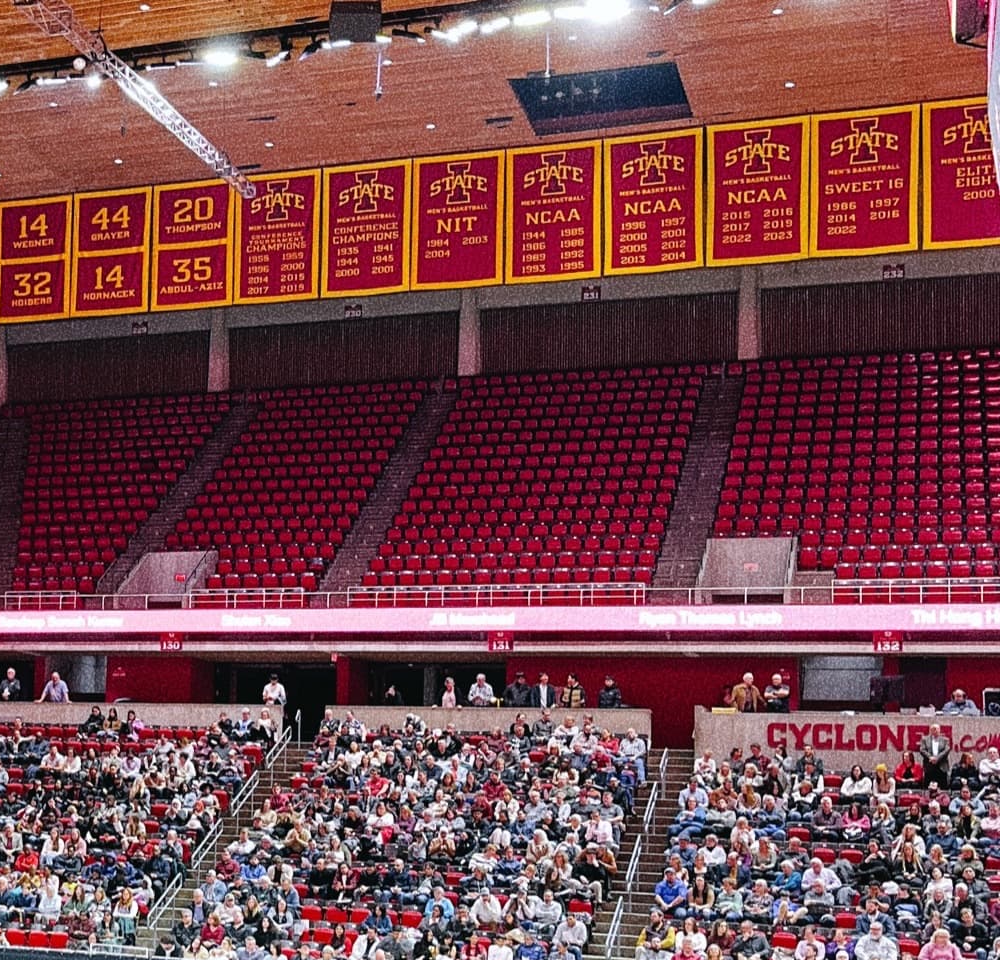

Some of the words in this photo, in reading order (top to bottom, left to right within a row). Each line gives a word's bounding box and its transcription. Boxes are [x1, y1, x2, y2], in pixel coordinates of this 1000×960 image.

[943, 120, 988, 145] STA
[830, 132, 898, 157] STATE
[725, 143, 790, 168] STATE
[941, 156, 965, 165] MEN'S
[622, 154, 685, 178] STATE
[828, 168, 851, 176] MEN'S
[852, 164, 900, 174] BASKETBALL
[956, 165, 996, 177] ELIT
[523, 165, 583, 189] STATE
[956, 175, 996, 188] EIGH
[430, 175, 487, 197] STATE
[824, 179, 884, 195] SWEET
[888, 178, 904, 190] 16
[338, 183, 394, 206] STATE
[728, 188, 787, 205] NCAA
[963, 189, 995, 201] 2000
[173, 197, 213, 223] 20
[251, 193, 304, 214] STATE
[625, 198, 681, 216] NCAA
[827, 202, 857, 212] 1986
[869, 198, 900, 208] 1997
[91, 205, 130, 230] 44
[526, 208, 580, 225] NCAA
[722, 211, 751, 221] 2015
[763, 207, 793, 217] 2016
[827, 214, 856, 223] 2014
[869, 210, 900, 221] 2016
[19, 214, 48, 238] 14
[165, 222, 221, 234] THOMPSON
[334, 222, 399, 235] CONFERENCE
[436, 216, 478, 234] NIT
[621, 221, 646, 231] 1996
[661, 217, 686, 227] 1997
[722, 223, 750, 232] 2017
[763, 220, 793, 229] 2019
[827, 226, 857, 235] 2022
[91, 231, 130, 241] GRAYER
[251, 231, 302, 240] CONFERENCE
[332, 231, 399, 245] CHAMPIONS
[462, 236, 488, 246] 2003
[522, 231, 546, 241] 1944
[619, 233, 647, 242] 2000
[661, 229, 686, 239] 2001
[722, 234, 752, 244] 2022
[763, 231, 793, 241] 2023
[246, 241, 306, 253] CHAMPIONS
[337, 247, 359, 257] 1935
[373, 244, 393, 253] 1941
[619, 244, 647, 254] 2005
[661, 240, 686, 250] 2012
[336, 257, 359, 267] 1944
[372, 254, 394, 264] 1945
[425, 250, 450, 259] 2004
[560, 250, 584, 260] 1992
[620, 255, 646, 264] 2013
[661, 252, 686, 262] 2014
[172, 257, 211, 283] 35
[281, 263, 305, 272] 2000
[335, 268, 360, 278] 2000
[371, 265, 394, 275] 2001
[521, 265, 546, 274] 1993
[560, 261, 584, 271] 1995
[14, 271, 51, 297] 32
[95, 265, 124, 290] 14
[248, 276, 269, 284] 2014
[83, 289, 135, 300] HORNACEK
[160, 282, 223, 294] ABDUL-AZIZ
[247, 286, 269, 295] 2017
[280, 284, 305, 293] 2019
[162, 641, 180, 650] 130
[493, 641, 510, 650] 131
[877, 641, 900, 651] 132
